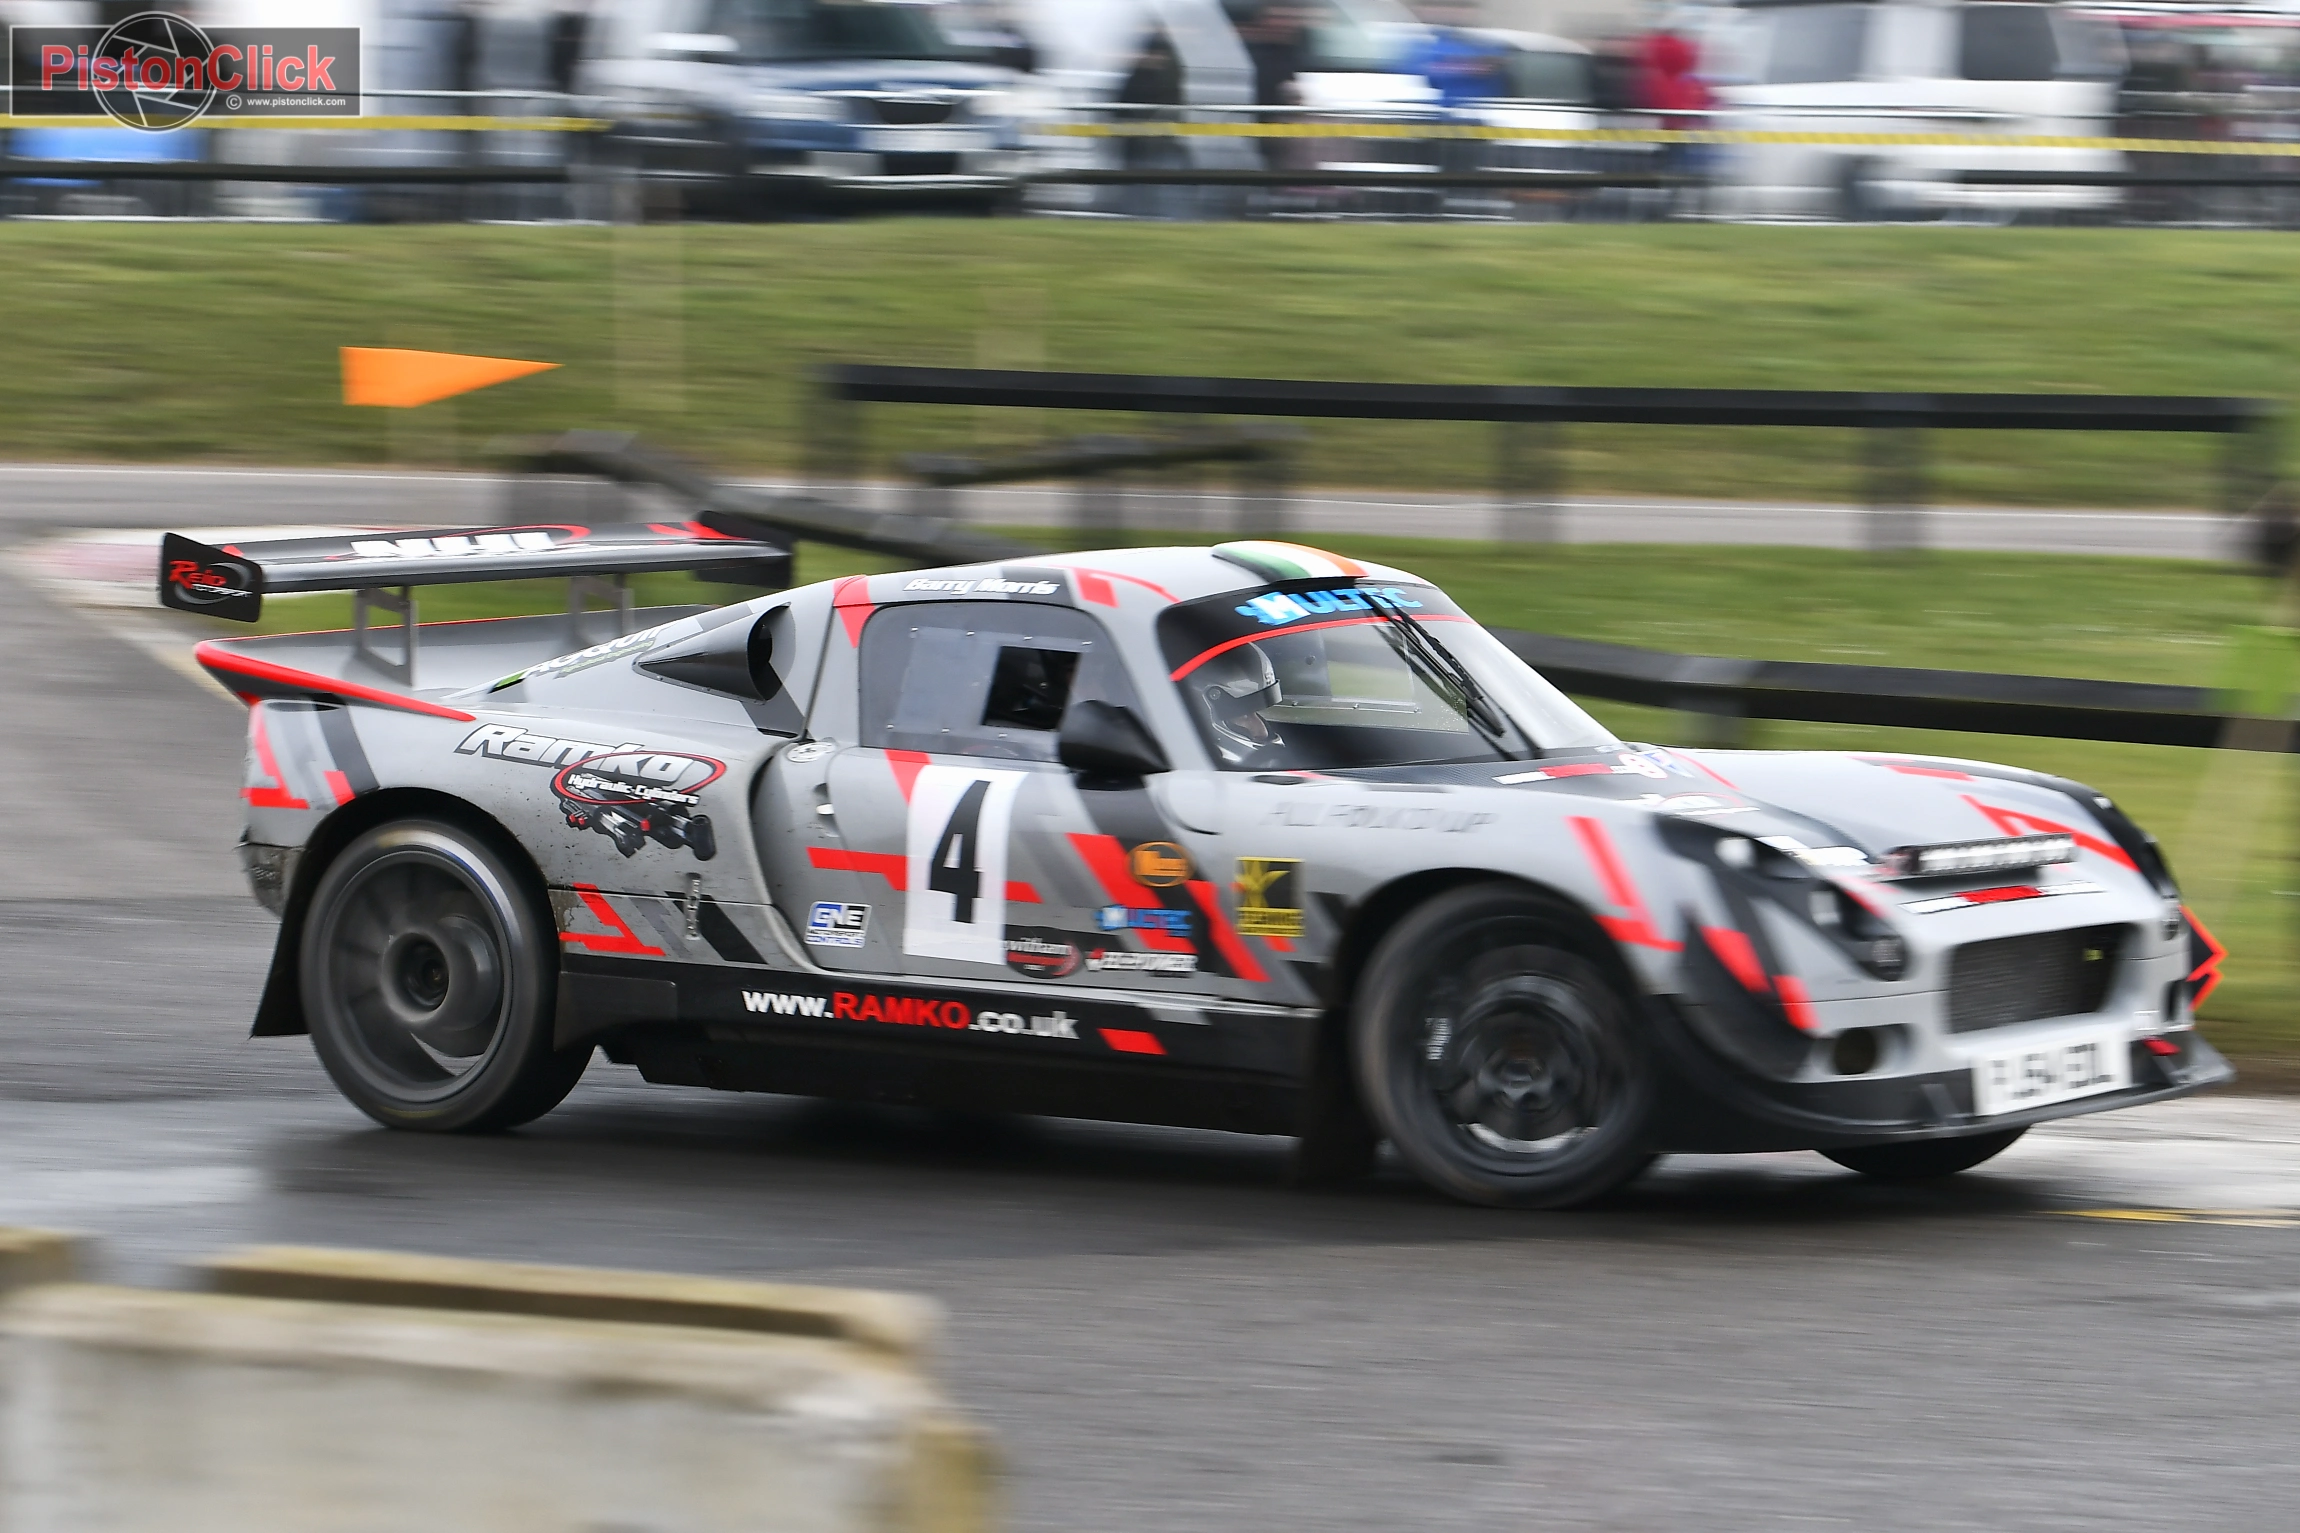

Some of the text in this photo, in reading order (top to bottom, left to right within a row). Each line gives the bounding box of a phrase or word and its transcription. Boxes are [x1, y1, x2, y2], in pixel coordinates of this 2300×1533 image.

[903, 578, 1060, 595] Barry Morris
[1247, 587, 1423, 625] MULTEC
[453, 723, 697, 783] Ramko
[567, 773, 700, 805] Hydraulic Cylinders
[927, 779, 992, 925] 4
[742, 990, 1080, 1039] www.RAMKO.co.uk
